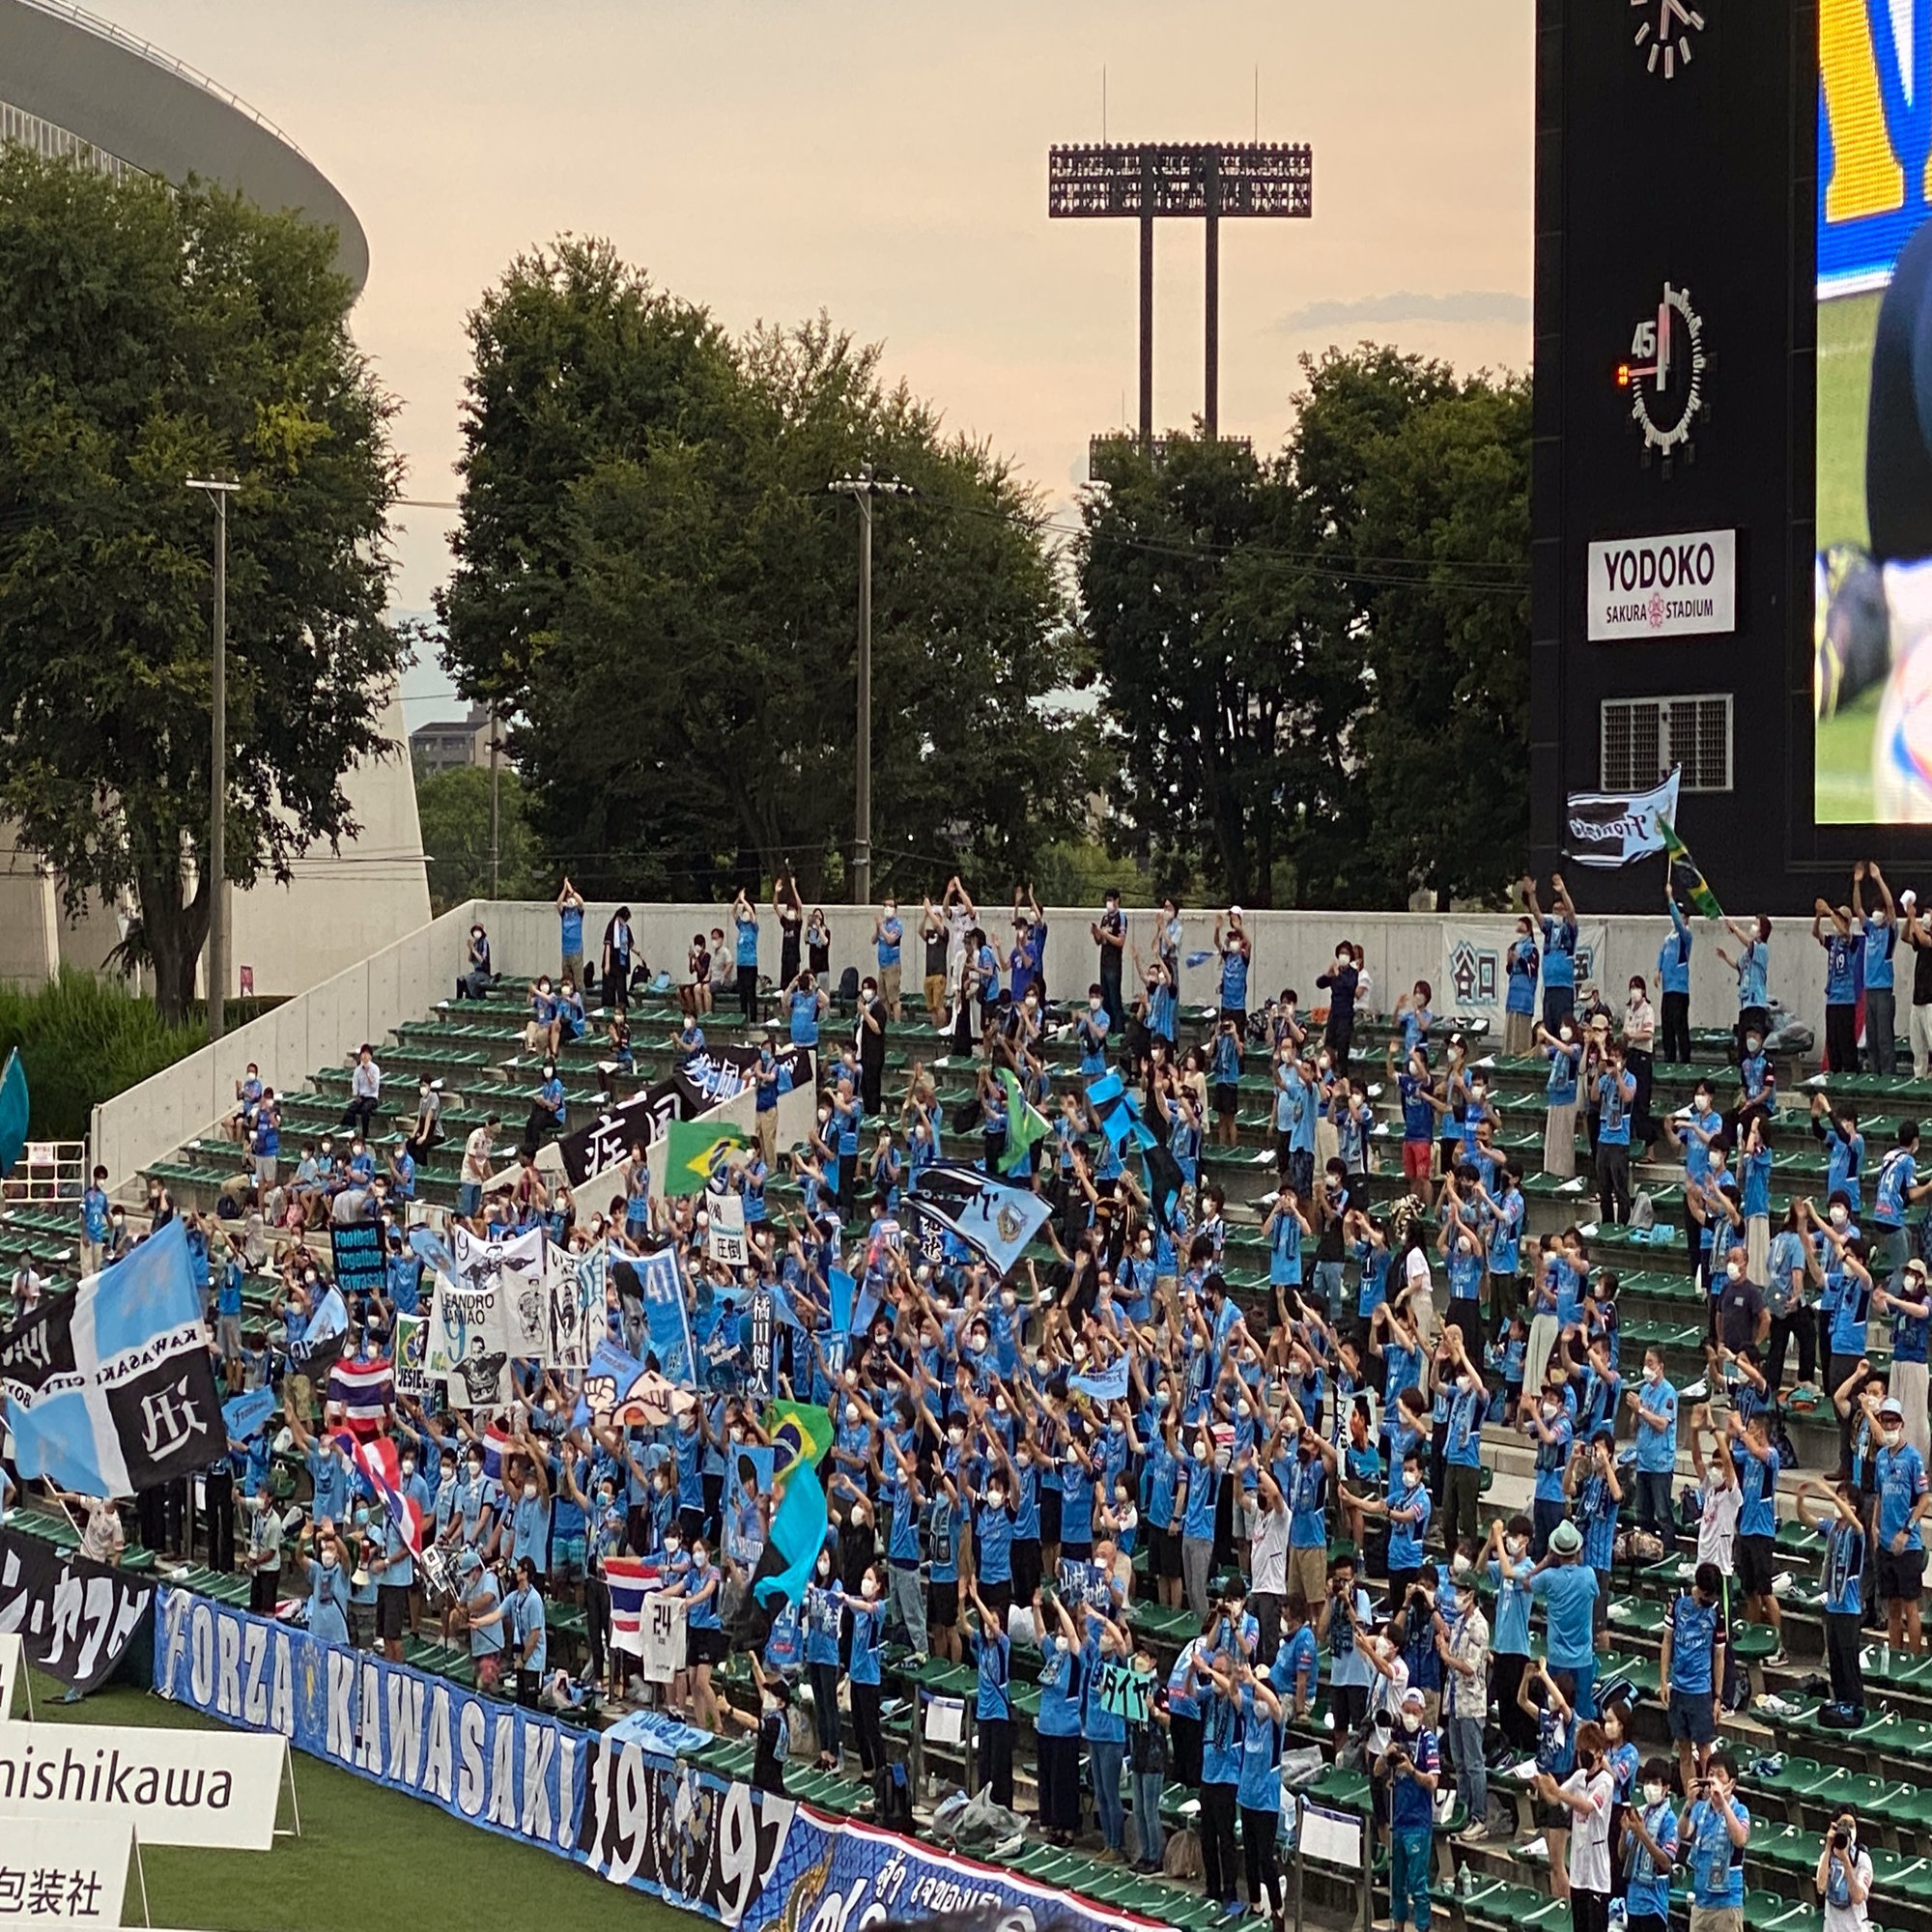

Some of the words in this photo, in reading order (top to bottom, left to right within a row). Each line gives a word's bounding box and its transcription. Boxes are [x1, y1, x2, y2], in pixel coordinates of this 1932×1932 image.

[1632, 321, 1656, 358] 45
[1605, 542, 1715, 591] YODOKO
[1606, 604, 1647, 623] SAKURA
[1666, 599, 1714, 619] STADIUM
[335, 1228, 378, 1248] Football
[337, 1248, 383, 1270] Together
[339, 1270, 385, 1292] Kawasaki
[646, 1264, 672, 1303] 41
[441, 1293, 495, 1310] LEANDRO
[653, 1605, 671, 1636] 24
[1102, 1667, 1149, 1719] ダイヤ
[153, 1588, 295, 1739] FORZA
[327, 1648, 578, 1850] KAWASAKI
[0, 1866, 101, 1917] 包装社
